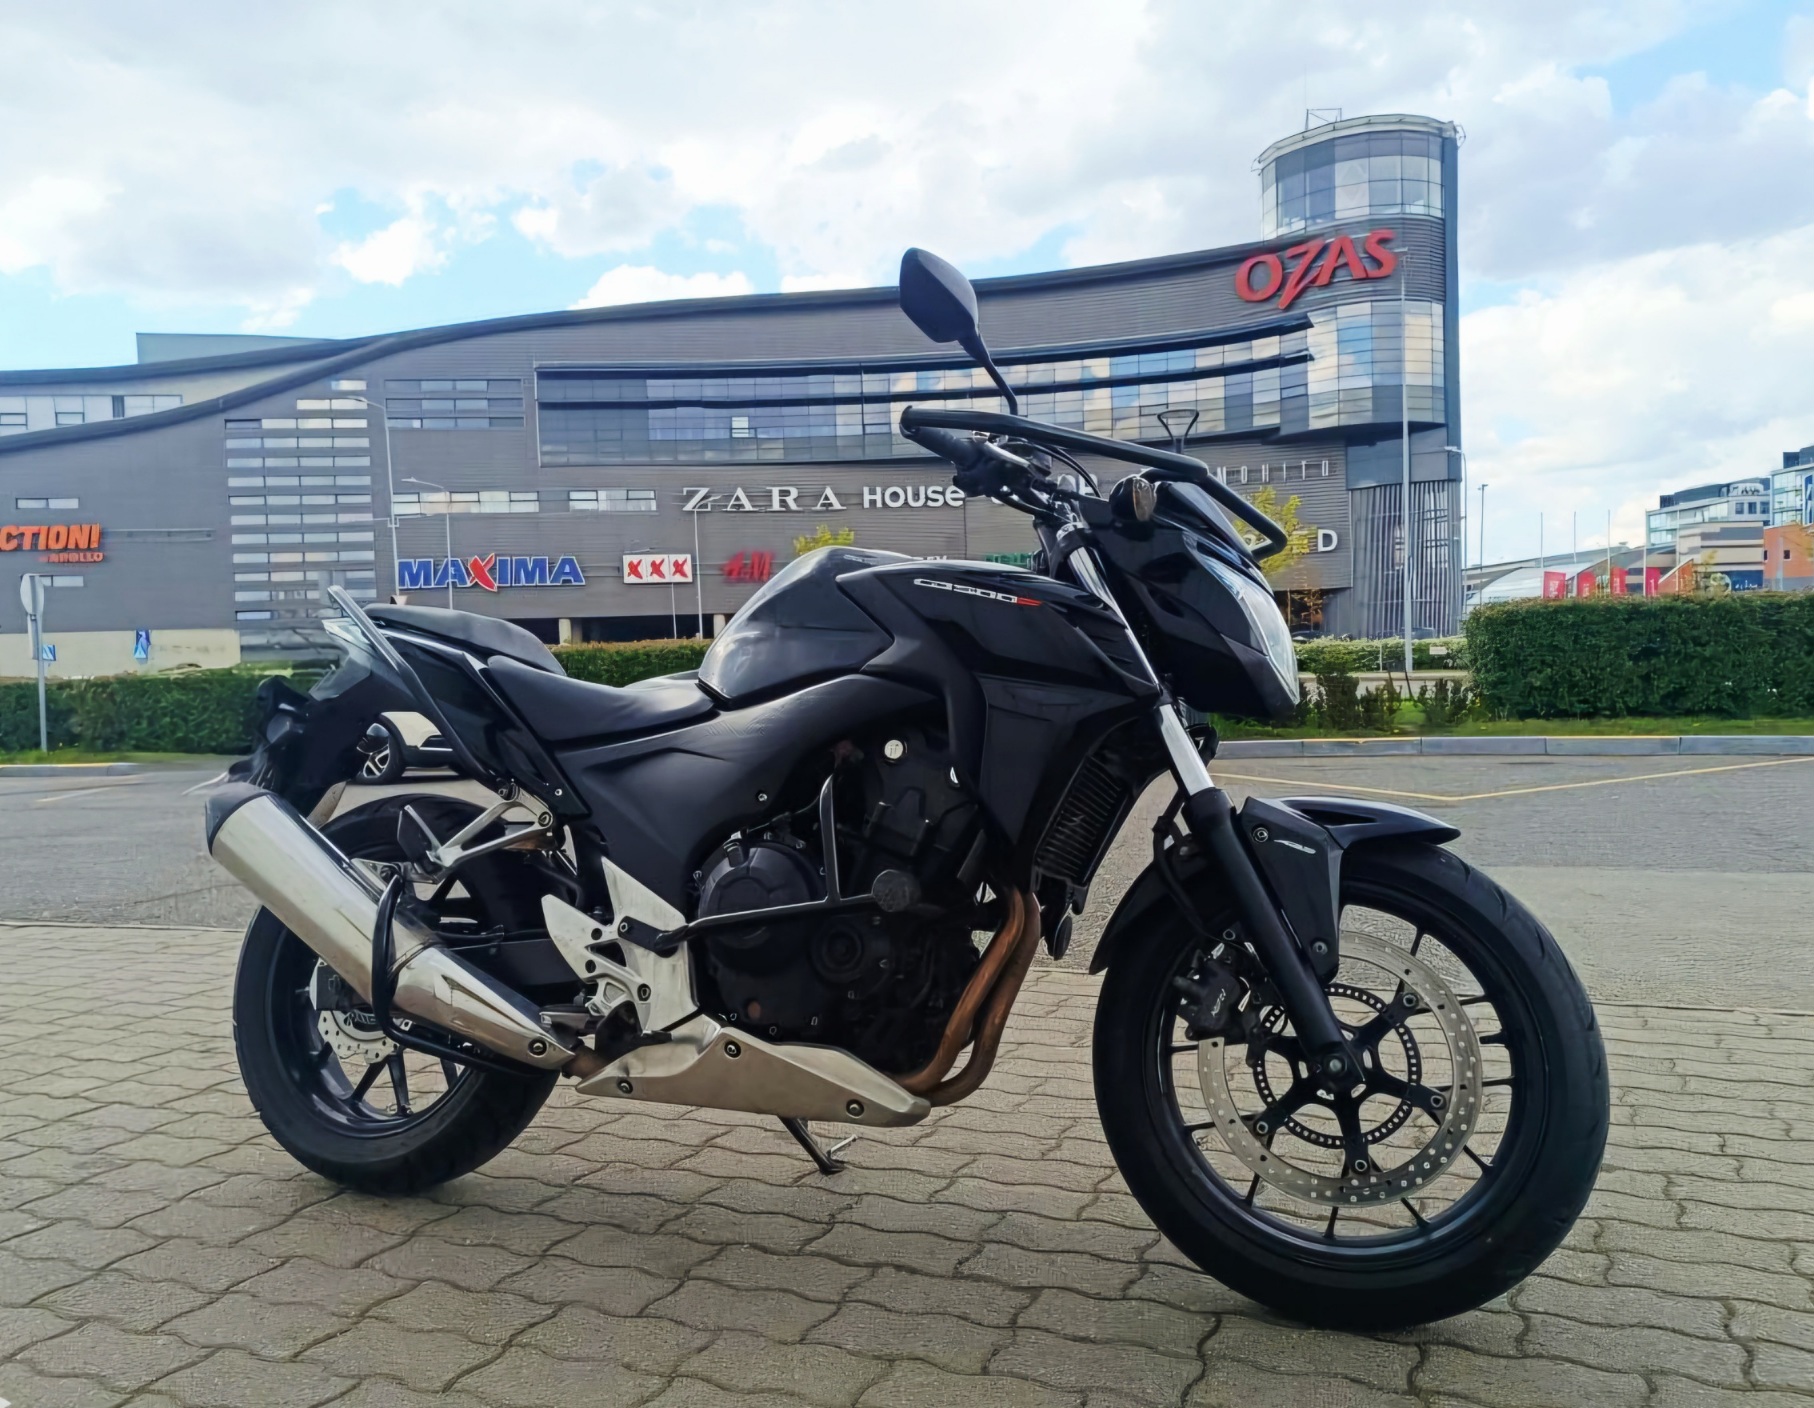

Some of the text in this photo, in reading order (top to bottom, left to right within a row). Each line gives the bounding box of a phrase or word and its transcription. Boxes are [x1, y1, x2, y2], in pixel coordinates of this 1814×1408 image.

[1235, 229, 1398, 310] OZAS
[682, 486, 847, 512] ZARA
[398, 552, 586, 592] MAXIMA
